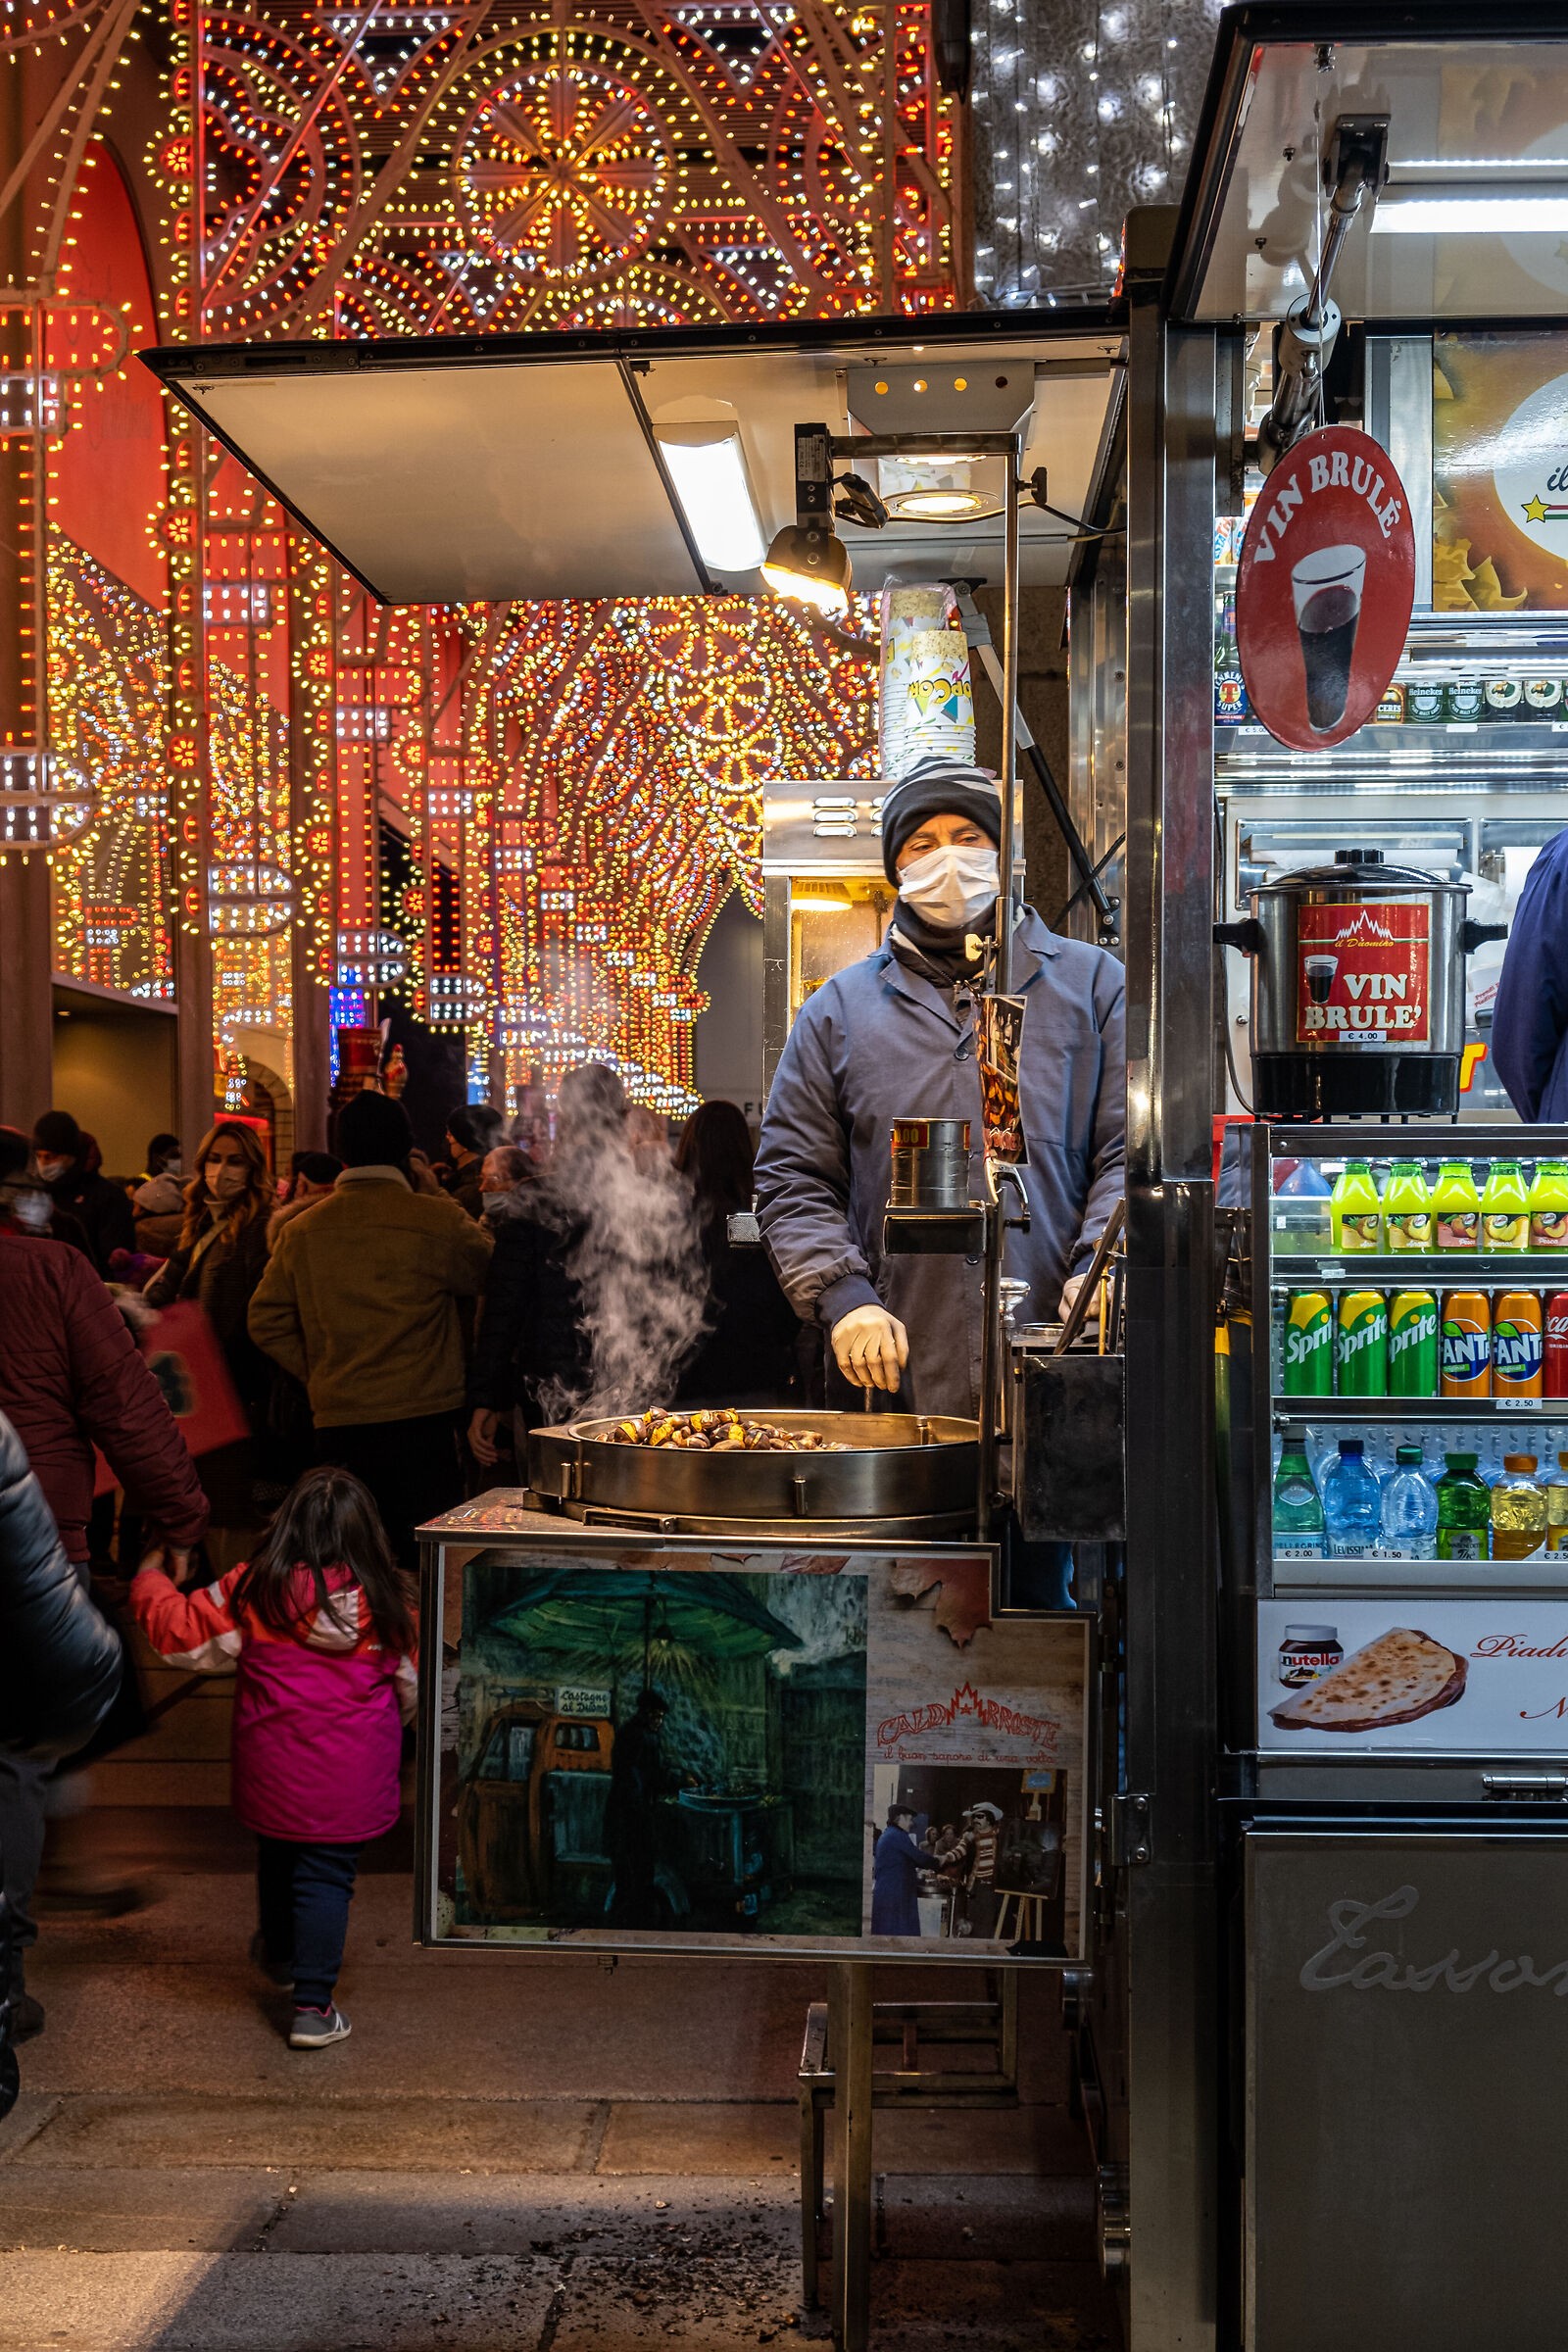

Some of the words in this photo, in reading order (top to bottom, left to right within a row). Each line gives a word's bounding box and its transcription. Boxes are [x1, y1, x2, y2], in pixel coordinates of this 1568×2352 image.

[1253, 473, 1303, 564] VIN
[1309, 451, 1402, 539] BRULÉ
[1221, 683, 1238, 703] T
[1217, 700, 1243, 710] SUPER
[1377, 704, 1401, 713] CERES
[1347, 938, 1395, 948] Duomino
[1343, 973, 1408, 1000] VIN
[1304, 1005, 1422, 1029] BRULE'
[1389, 1313, 1437, 1364] prite
[1282, 1652, 1340, 1666] nutella
[885, 1745, 893, 1759] il
[898, 1746, 927, 1760] buon
[932, 1753, 972, 1765] sapore
[977, 1750, 989, 1760] di
[1026, 1750, 1055, 1764] volta
